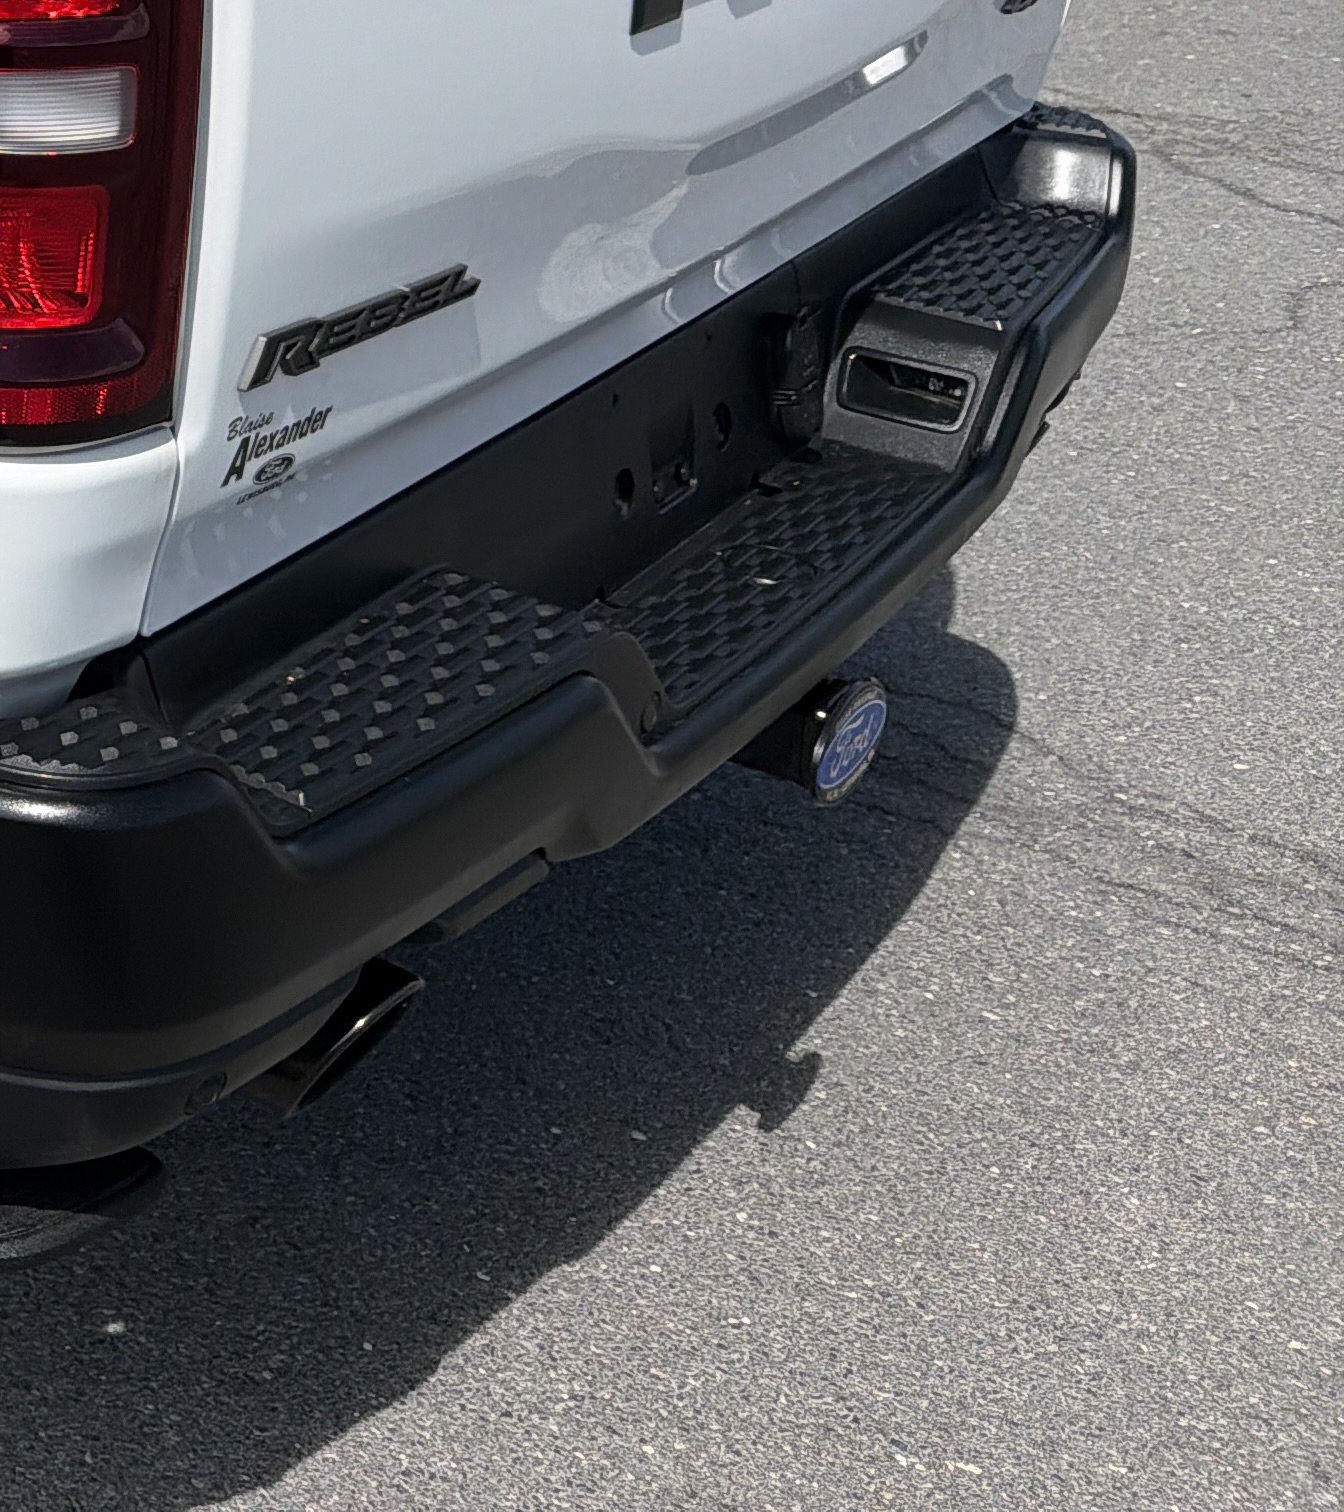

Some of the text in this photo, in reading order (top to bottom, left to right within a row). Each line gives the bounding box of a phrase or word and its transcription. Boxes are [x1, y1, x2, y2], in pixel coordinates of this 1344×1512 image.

[237, 263, 482, 393] REBEL
[220, 405, 334, 489] Alexander
[227, 411, 274, 442] Blaise
